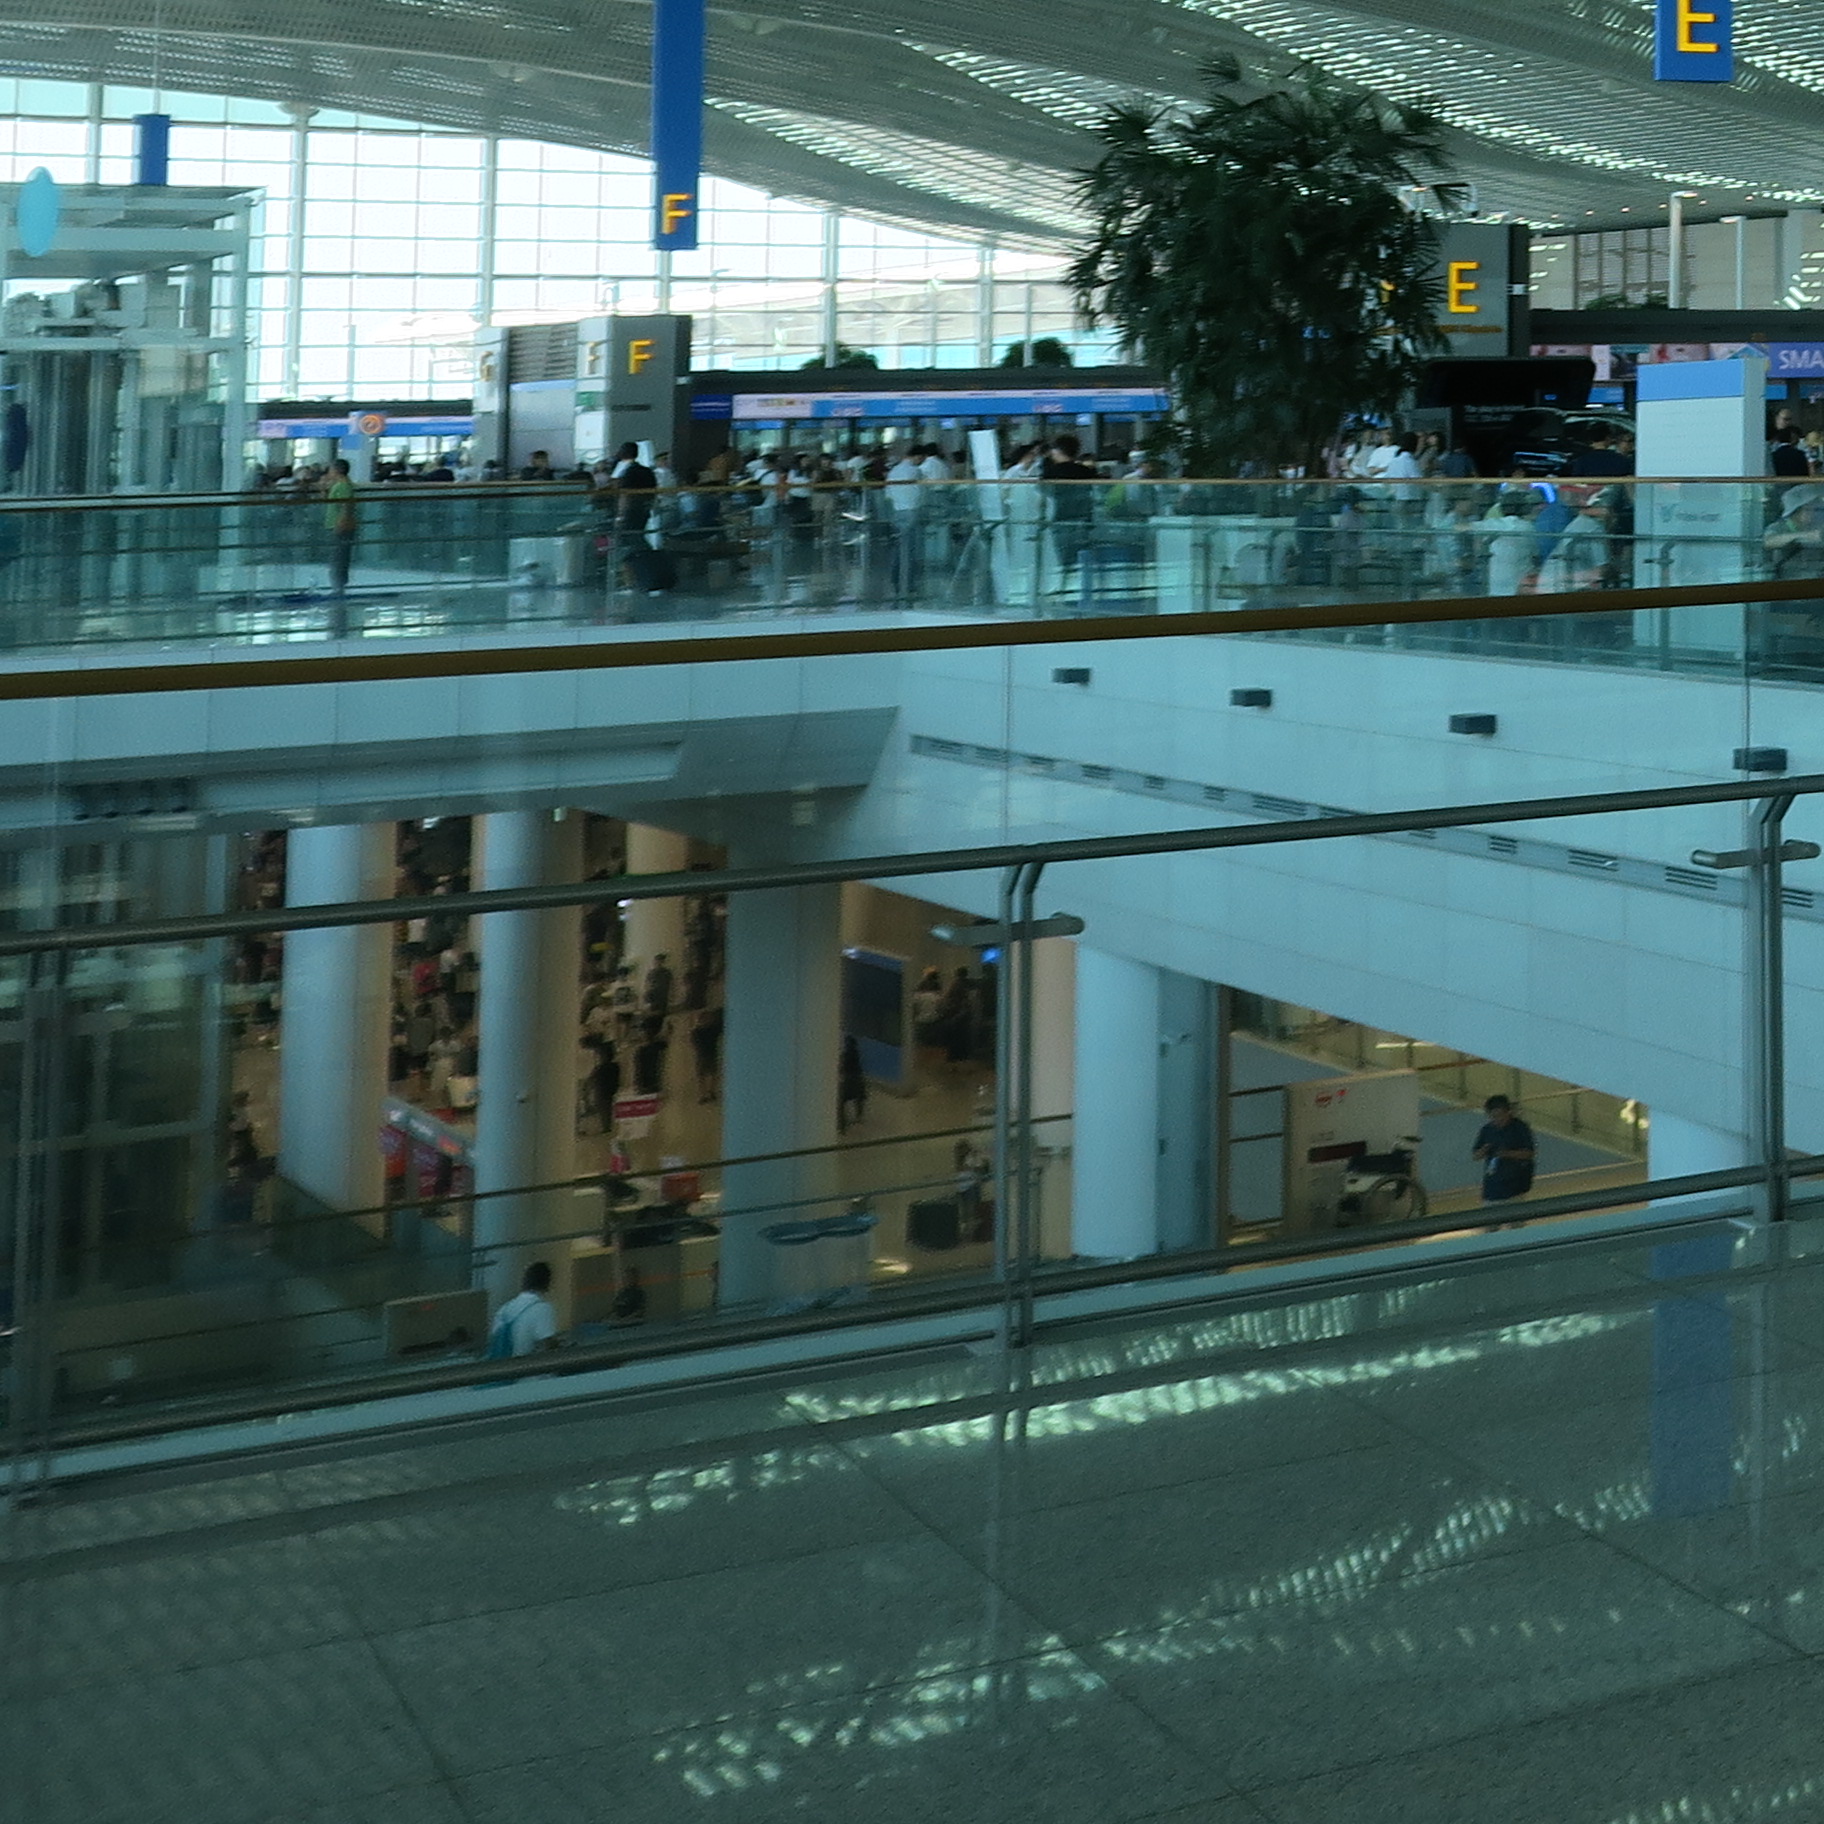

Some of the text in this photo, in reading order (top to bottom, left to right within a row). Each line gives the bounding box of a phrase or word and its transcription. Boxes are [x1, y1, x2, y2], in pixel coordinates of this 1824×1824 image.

[661, 192, 693, 235] F
[1447, 261, 1482, 314] E
[628, 339, 655, 374] F
